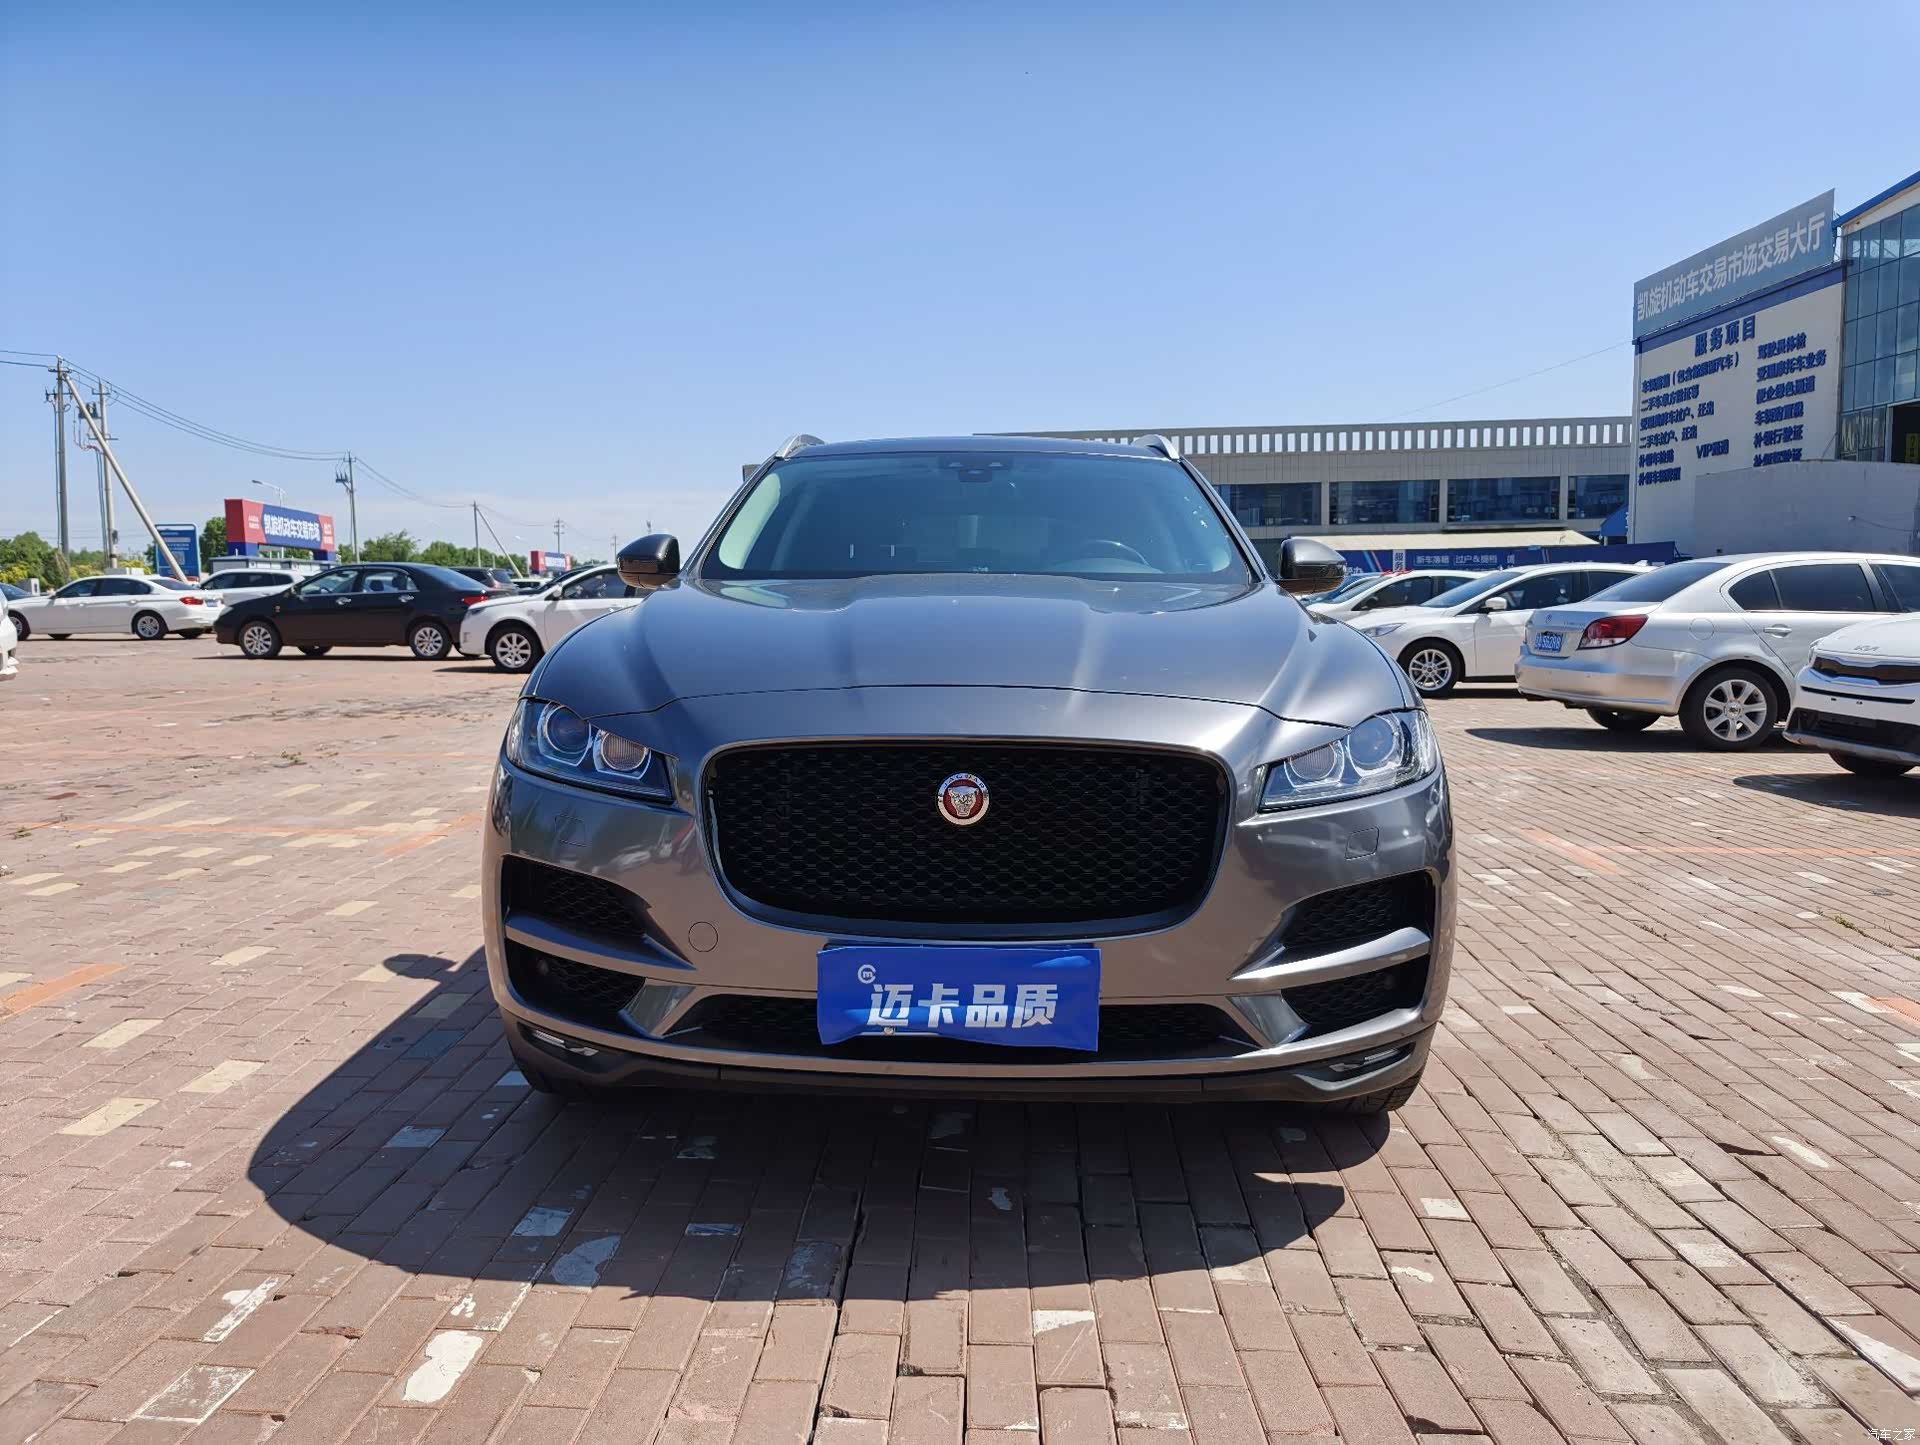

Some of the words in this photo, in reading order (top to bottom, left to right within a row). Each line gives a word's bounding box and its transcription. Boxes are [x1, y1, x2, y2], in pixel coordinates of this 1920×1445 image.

[1637, 212, 1825, 321] 凯旋机动车交易市场交易大厅
[1695, 315, 1755, 357] 服务项目
[264, 513, 320, 541] 凯旋机动车交易市场
[867, 983, 1058, 1028] 迈卡品质
